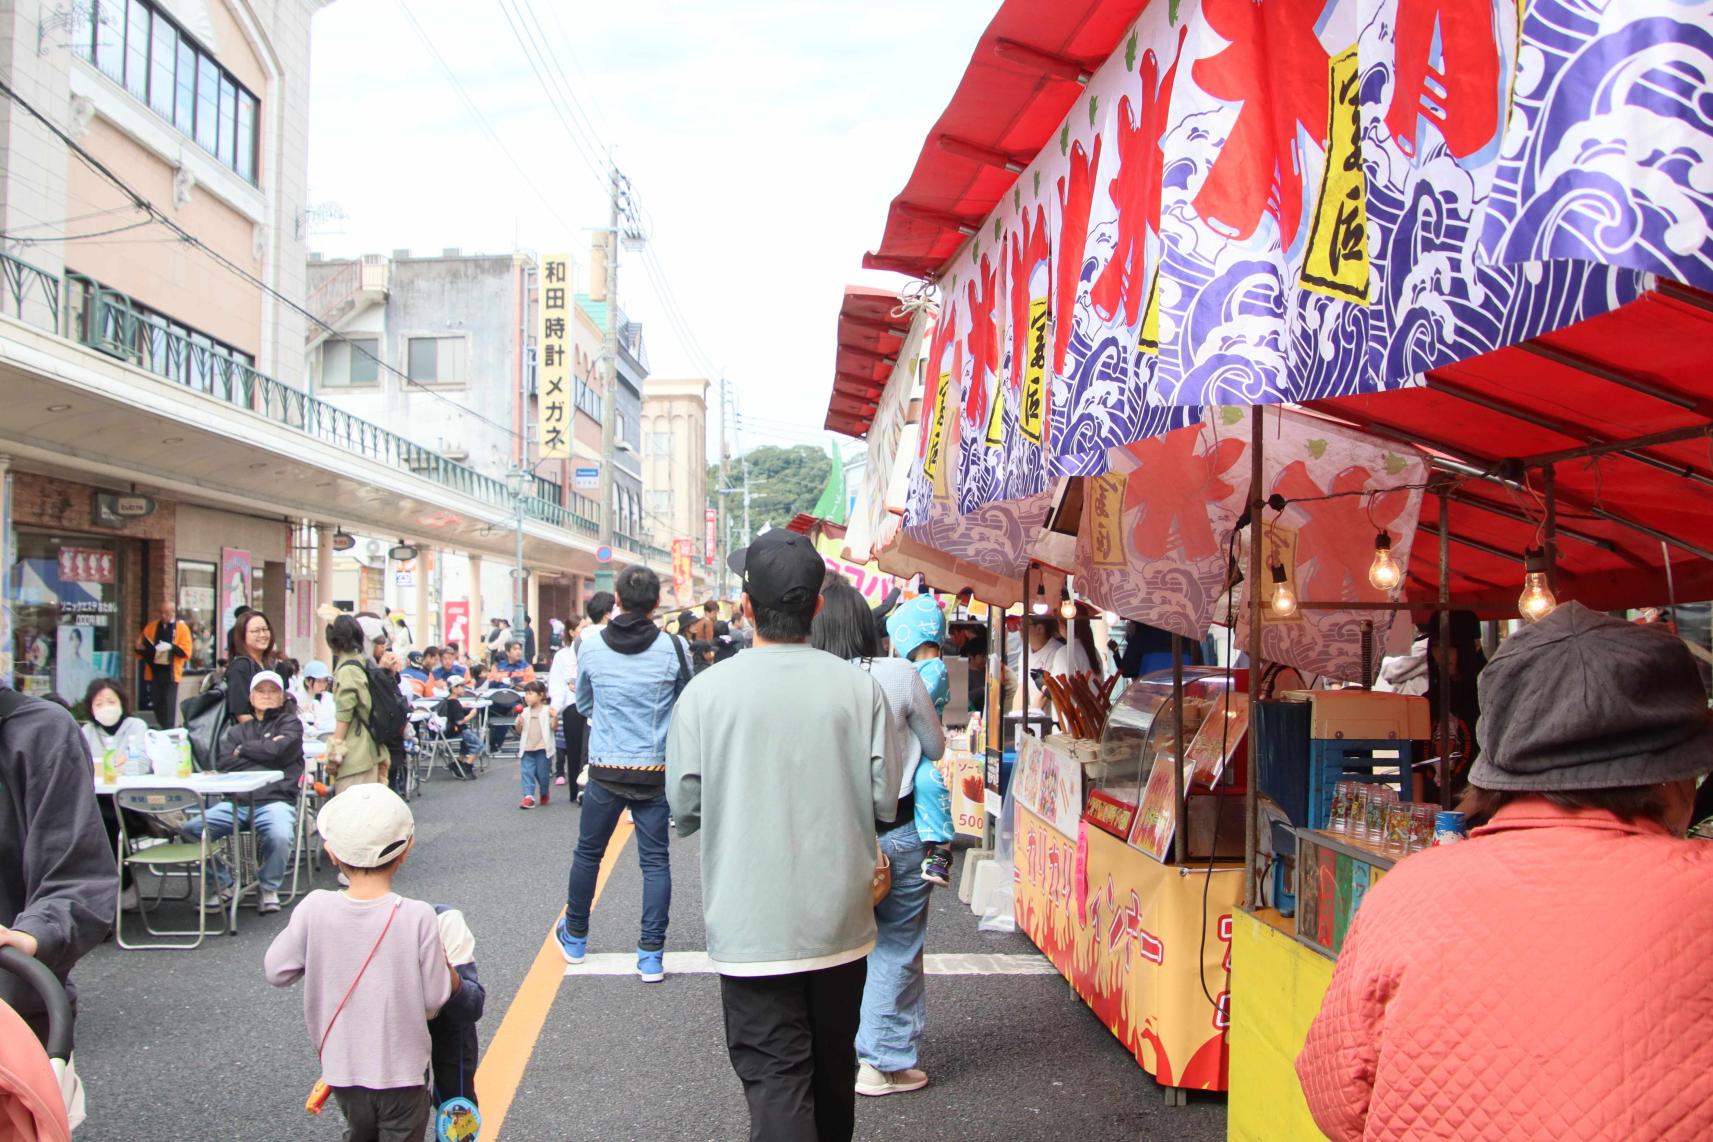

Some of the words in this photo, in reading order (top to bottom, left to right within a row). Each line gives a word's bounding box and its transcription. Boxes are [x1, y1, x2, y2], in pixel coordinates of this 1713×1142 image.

[545, 261, 566, 450] 和田時計メガネ
[959, 813, 984, 830] 500
